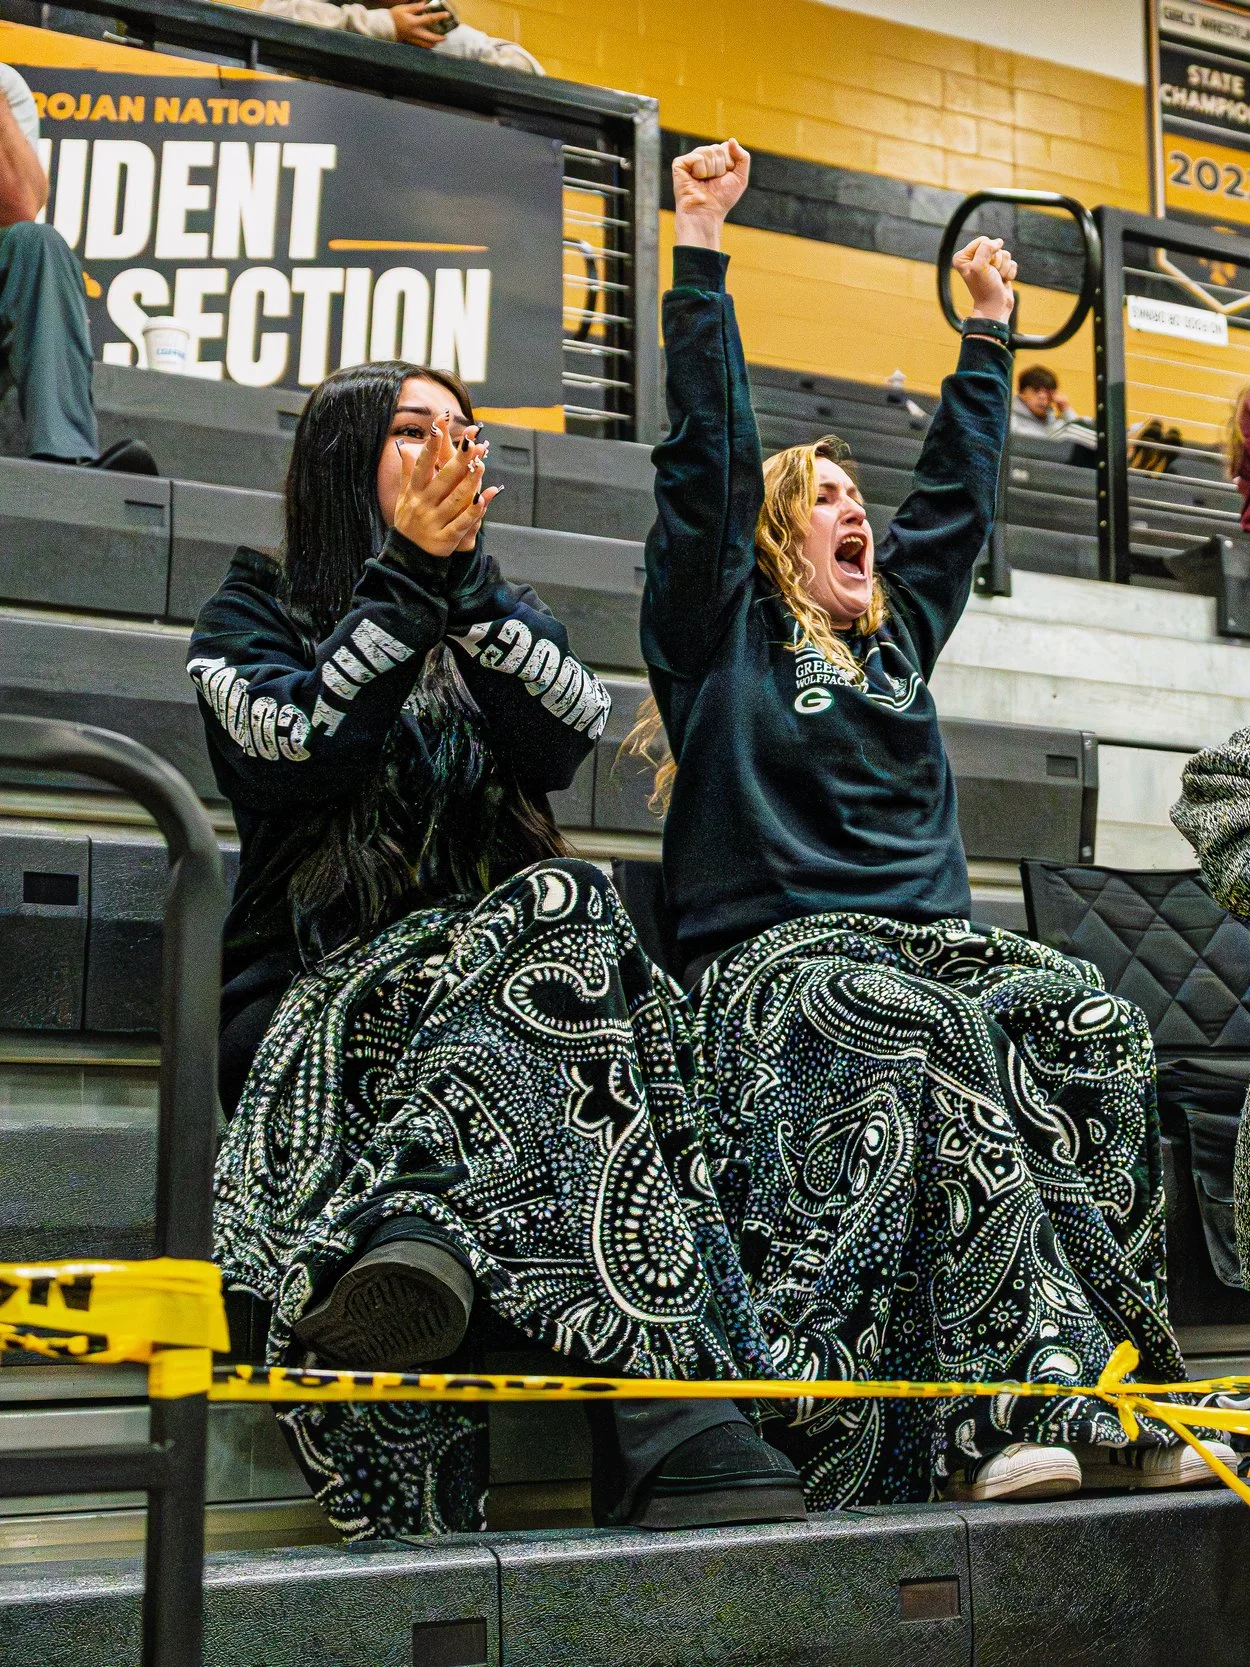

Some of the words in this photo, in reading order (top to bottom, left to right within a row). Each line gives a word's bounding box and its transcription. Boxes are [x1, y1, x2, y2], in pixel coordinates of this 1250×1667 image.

[1186, 64, 1246, 97] STATE
[31, 91, 147, 123] ROJAN
[153, 95, 292, 127] NATION
[35, 138, 338, 260] UDENT
[102, 266, 492, 388] SECTION
[795, 673, 854, 690] WOLFPACK
